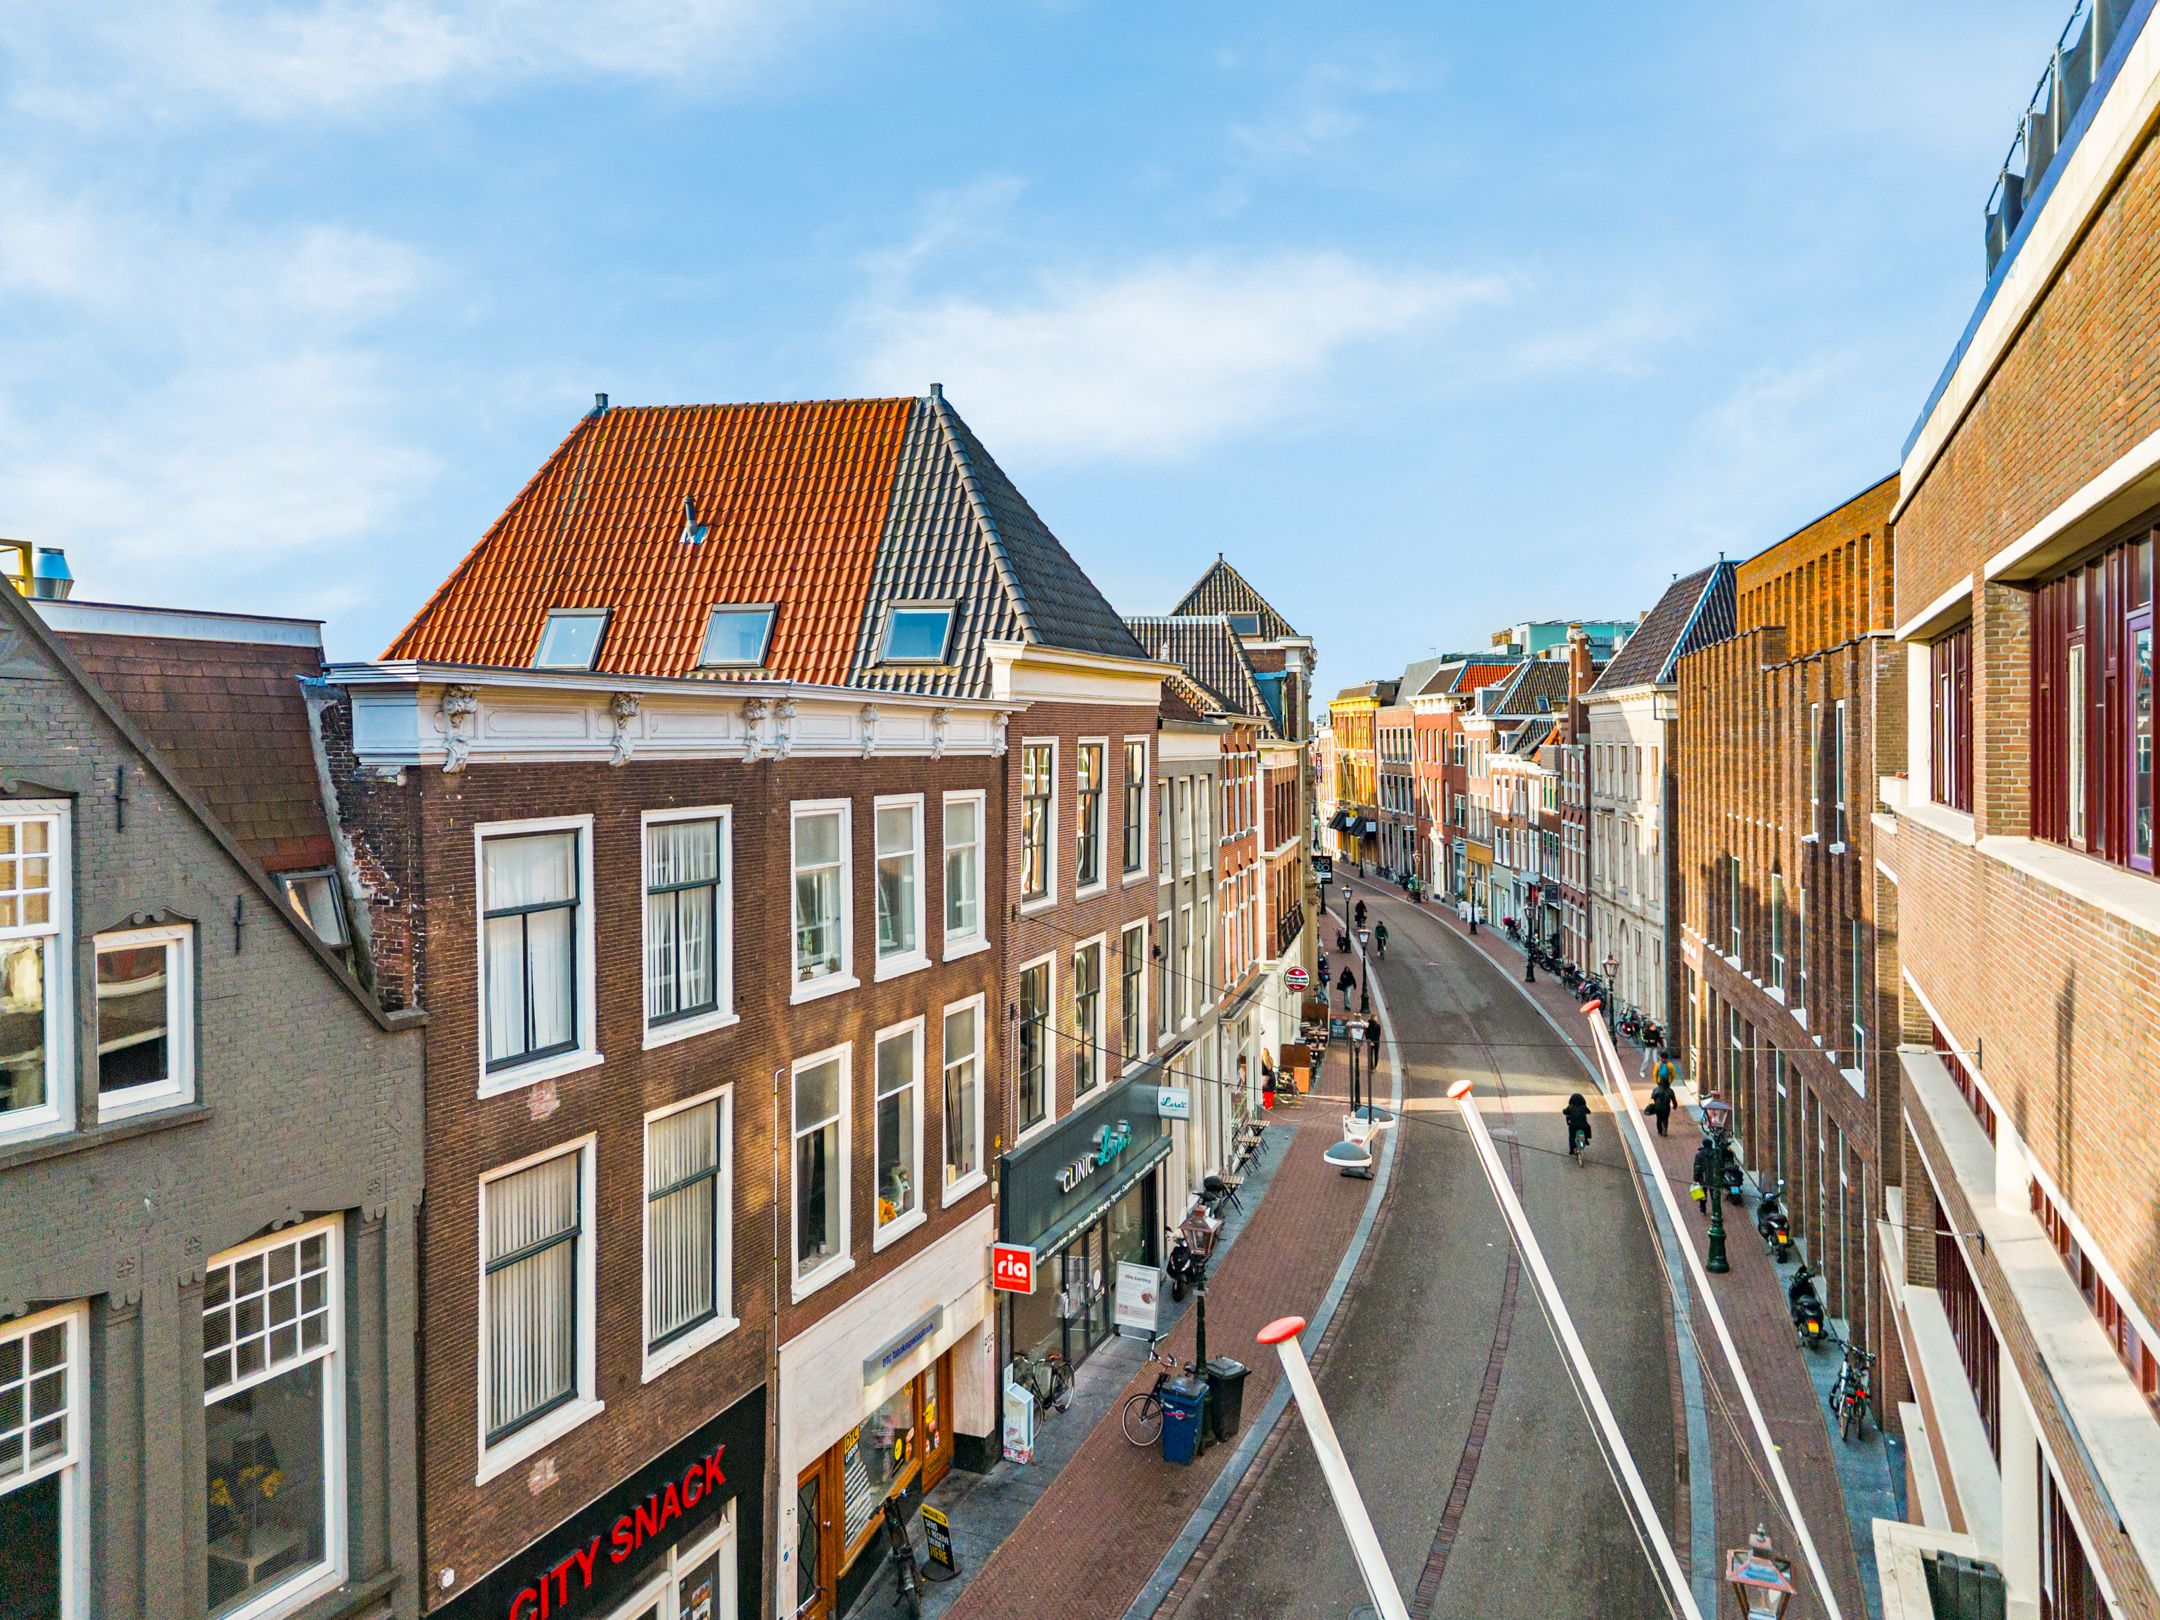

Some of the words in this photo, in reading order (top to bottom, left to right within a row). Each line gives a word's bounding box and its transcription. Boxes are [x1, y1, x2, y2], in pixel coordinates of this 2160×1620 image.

[1063, 1153, 1095, 1193] CLINIC
[998, 1253, 1027, 1278] ria
[845, 1426, 859, 1450] DTC
[509, 1536, 601, 1620] CITY
[610, 1445, 726, 1564] SNACK
